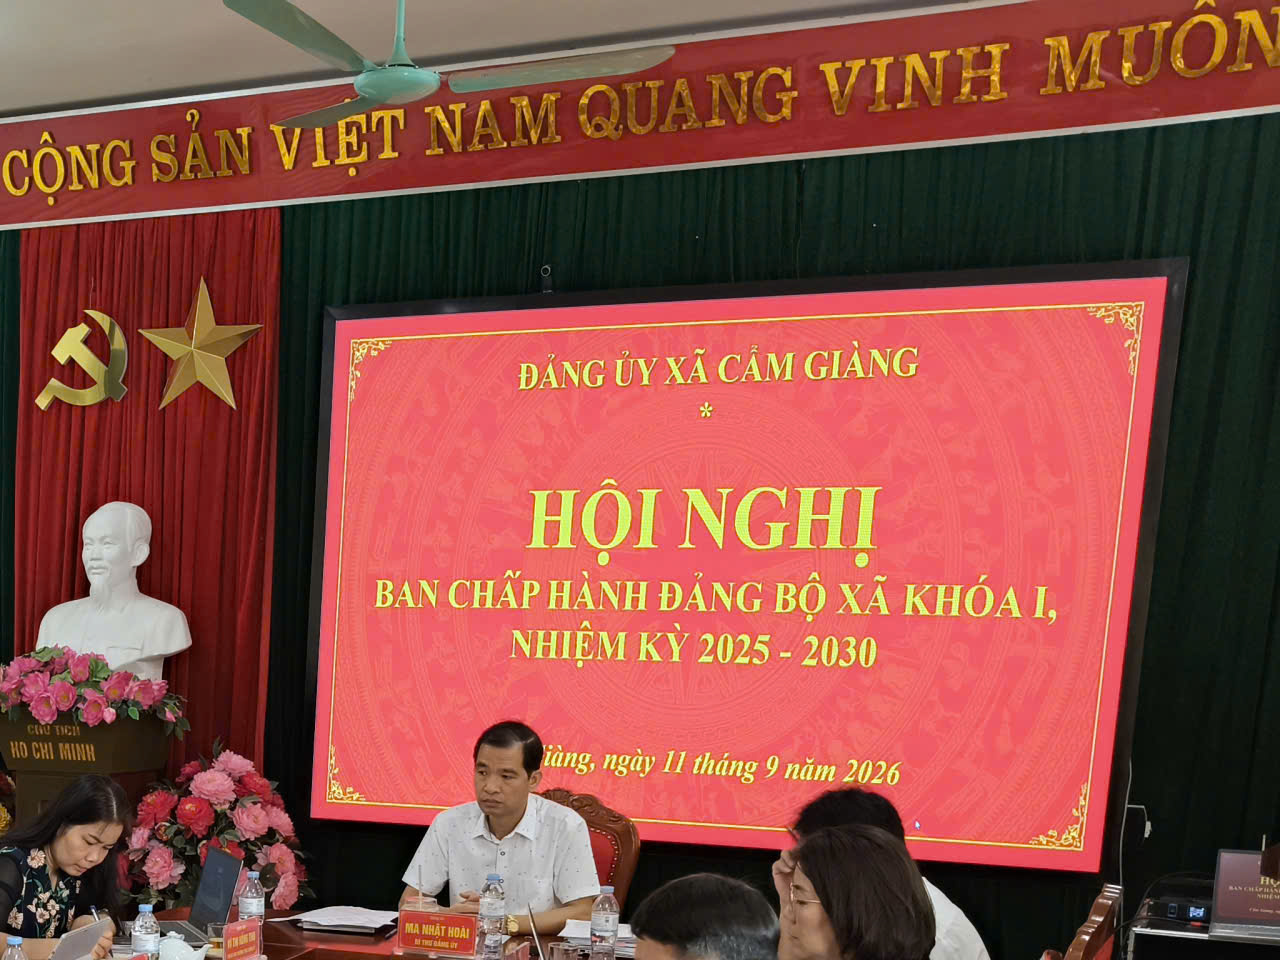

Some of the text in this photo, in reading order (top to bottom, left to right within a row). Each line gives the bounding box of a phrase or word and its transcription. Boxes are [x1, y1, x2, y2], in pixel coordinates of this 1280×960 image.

[2, 131, 136, 206] CỘNG
[152, 110, 252, 182] SẢN
[270, 98, 404, 178] VIỆT
[425, 92, 562, 156] NAM
[578, 66, 798, 142] QUANG
[820, 43, 1009, 116] VINH
[1040, 0, 1280, 96] MUÔN
[518, 341, 919, 390] ĐẢNG ỦY XÃ CẨM GIÀNG
[525, 478, 881, 568] HỘI NGHỊ
[374, 570, 1057, 625] BAN CHẤP HÀNH ĐẢNG BỘ XÃ KHÓA I,
[509, 620, 627, 668] NHIỆM
[637, 623, 690, 662] KỲ
[697, 634, 770, 665] 2025
[801, 636, 877, 668] 2030
[58, 743, 96, 762] MINH
[542, 744, 902, 785] iàng, ngày 11 tháng 9 năm 2026
[405, 923, 420, 934] MA
[422, 923, 446, 939] NHẬT
